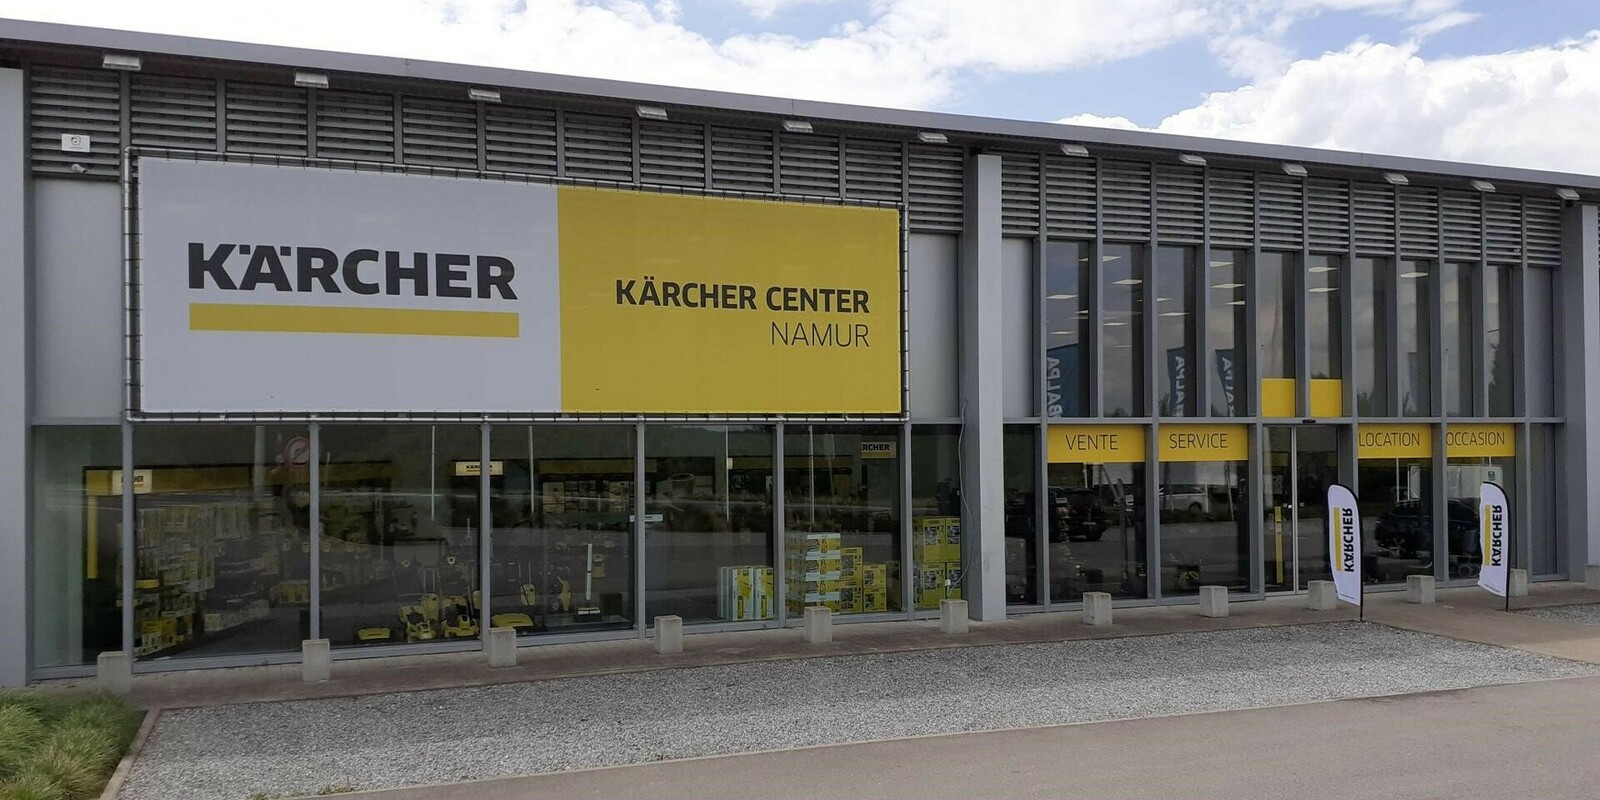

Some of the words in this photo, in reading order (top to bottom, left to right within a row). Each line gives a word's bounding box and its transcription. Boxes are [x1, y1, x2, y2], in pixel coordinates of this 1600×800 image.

[188, 242, 517, 300] KÄRCHER
[615, 277, 758, 310] KÄRCHER
[766, 286, 870, 314] CENTER
[771, 321, 870, 348] NAMUR
[862, 443, 890, 451] RCHER
[1065, 434, 1119, 450] VENTE
[1169, 433, 1228, 449] SERVICE
[1358, 431, 1420, 447] LOCATION
[1446, 431, 1506, 447] OCCASION
